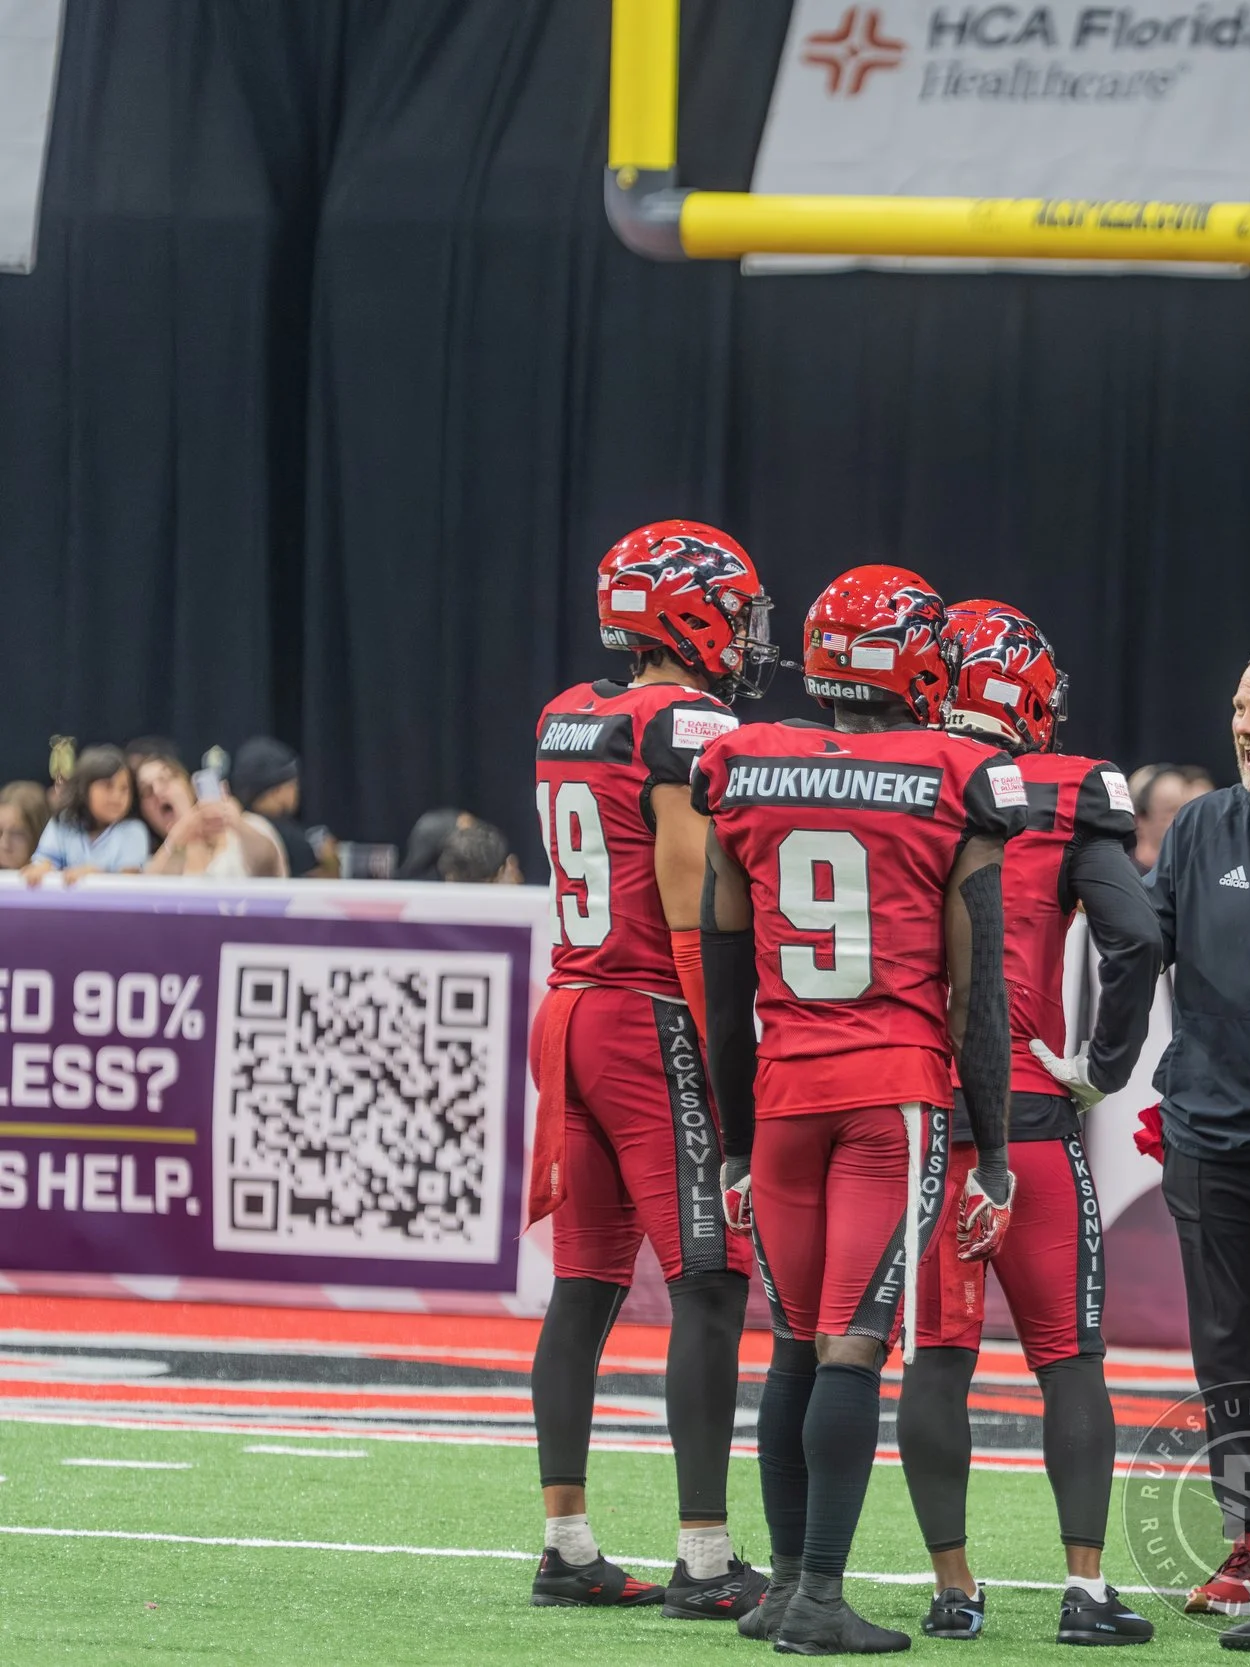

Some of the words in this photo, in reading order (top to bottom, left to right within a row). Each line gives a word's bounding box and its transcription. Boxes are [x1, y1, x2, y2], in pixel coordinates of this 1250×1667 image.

[926, 6, 1057, 50] HCA
[807, 679, 870, 700] Riddell
[840, 655, 847, 665] 9
[540, 722, 603, 751] BROWN
[725, 766, 939, 807] CHUKWUNEKE
[536, 781, 612, 947] 19
[1219, 877, 1250, 890] adidas
[776, 829, 874, 1000] 9
[73, 970, 206, 1041] 90%
[0, 1042, 180, 1113] ESS?
[668, 1015, 716, 1239] JACKSONVILLE
[37, 1151, 202, 1217] HELP.
[1064, 1133, 1102, 1328] CKSONVILLE
